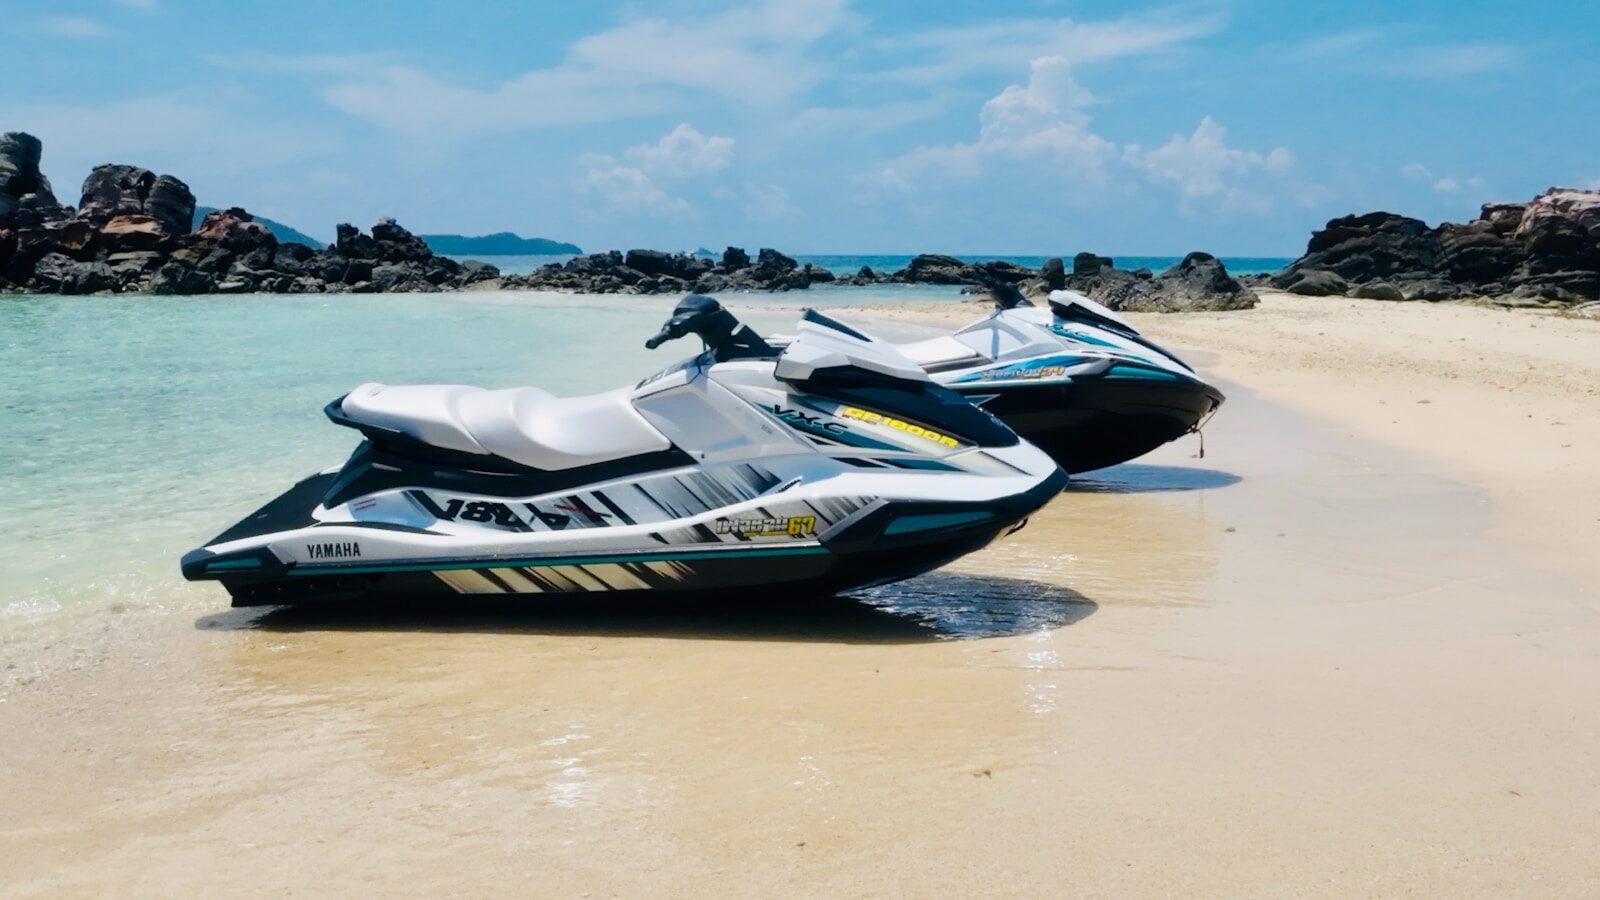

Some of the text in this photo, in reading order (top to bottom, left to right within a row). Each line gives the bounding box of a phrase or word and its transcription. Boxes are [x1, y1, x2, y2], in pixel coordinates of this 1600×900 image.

[773, 404, 849, 435] VX-C
[786, 516, 816, 535] 67
[306, 541, 361, 559] YAMAHA
